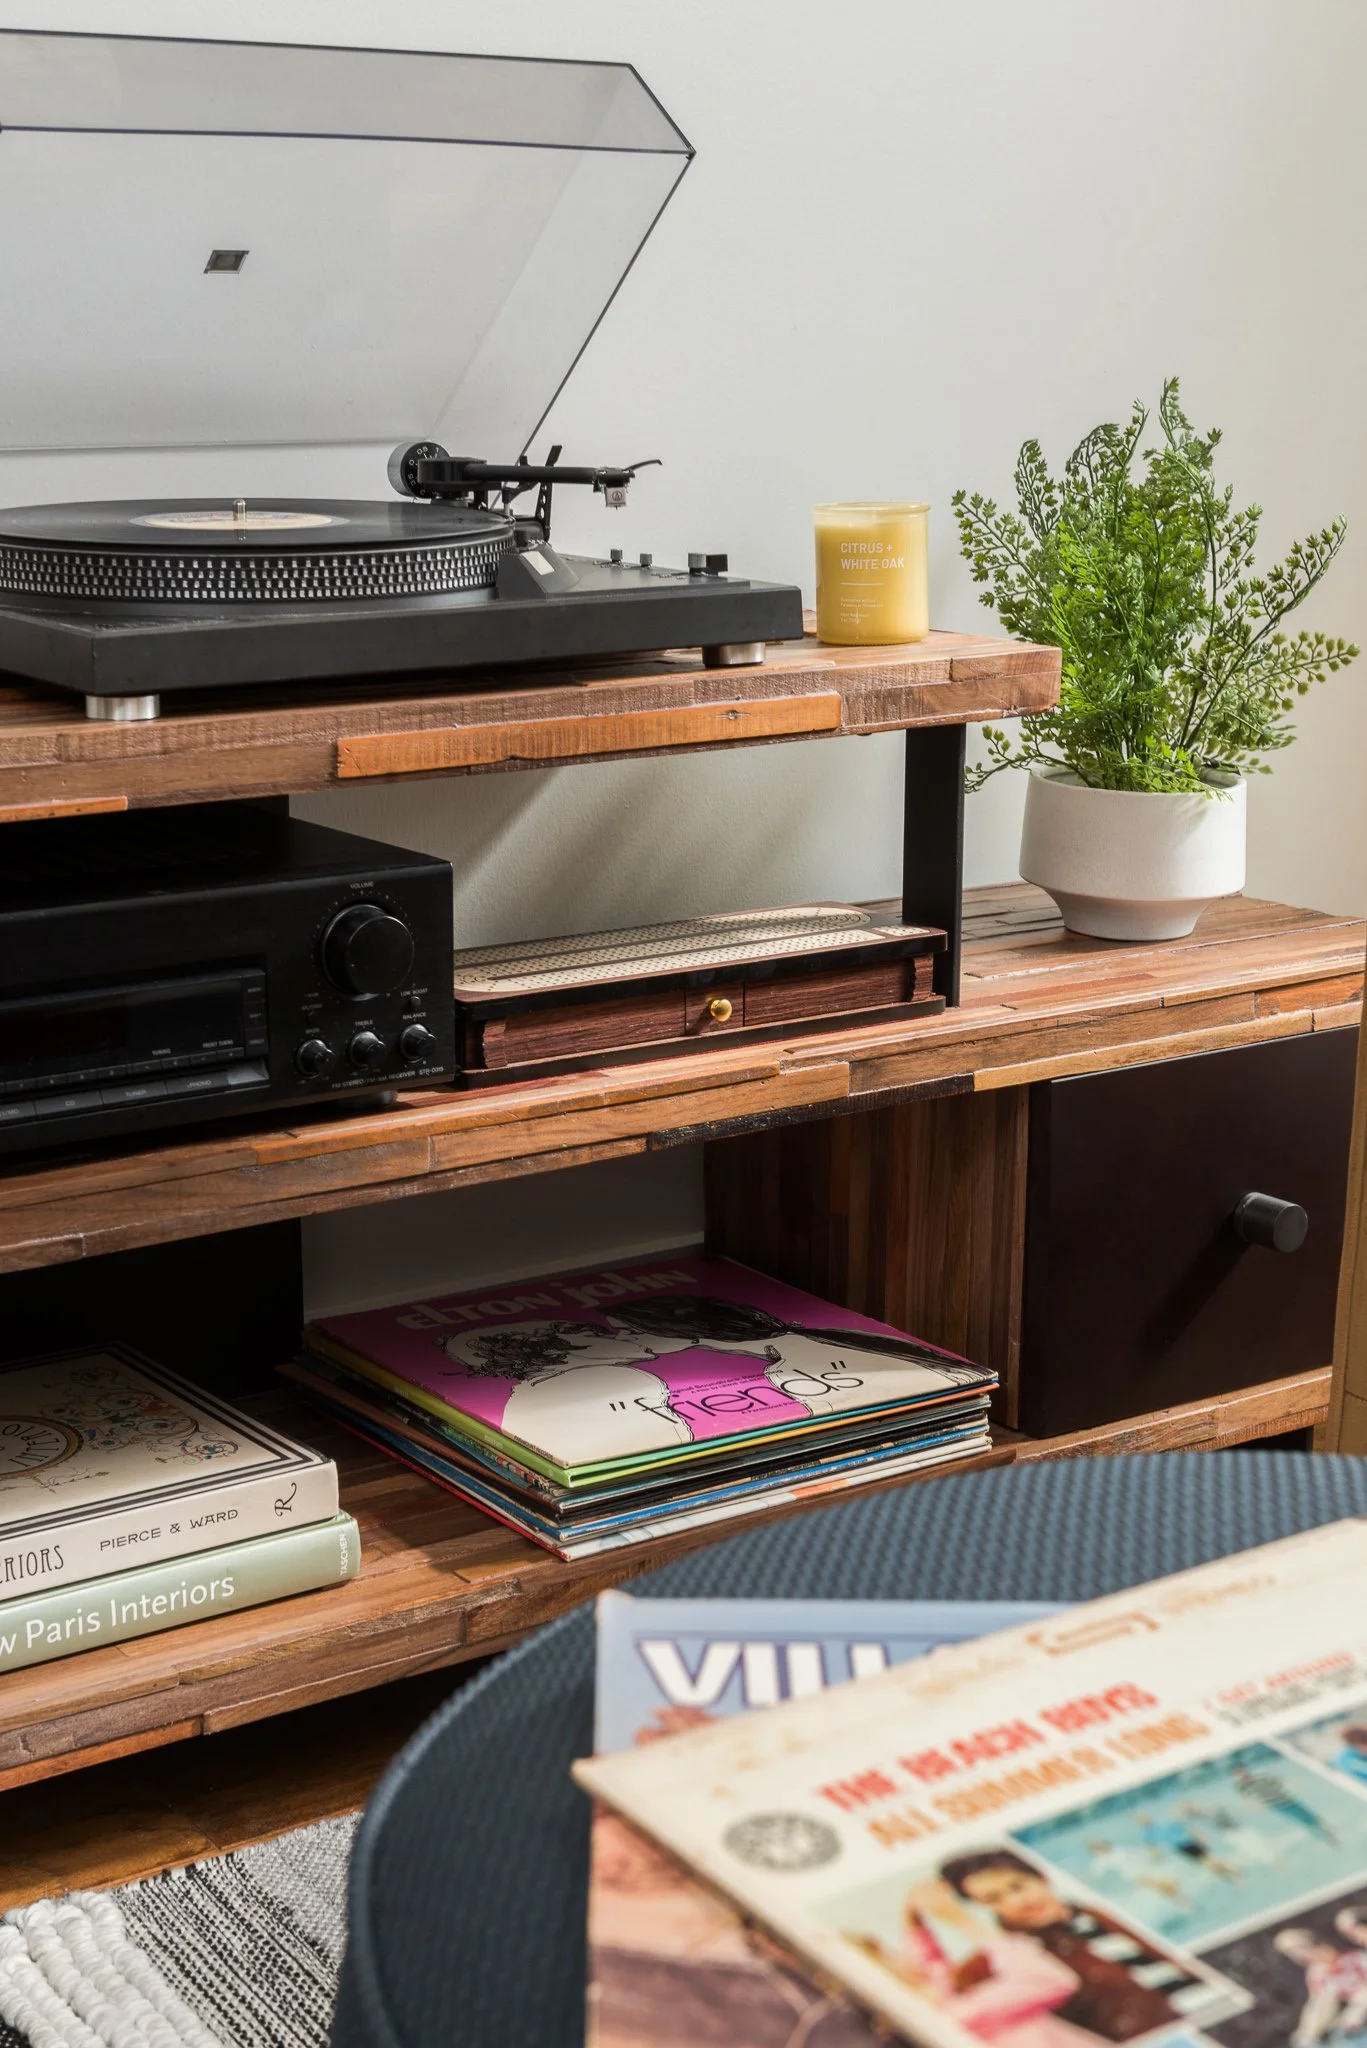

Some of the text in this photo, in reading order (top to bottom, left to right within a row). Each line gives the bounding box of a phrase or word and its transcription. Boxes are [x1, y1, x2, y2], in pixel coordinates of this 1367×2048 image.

[841, 542, 883, 553] CITRUS
[841, 557, 905, 570] WHITE OAK
[350, 881, 374, 889] VOLUME
[402, 1012, 426, 1020] BALANCE
[0, 1509, 239, 1584] RIORS PIERCE & WARD
[340, 1531, 349, 1577] TASCHEN
[26, 1608, 101, 1649] Paris
[110, 1575, 235, 1627] Interiors
